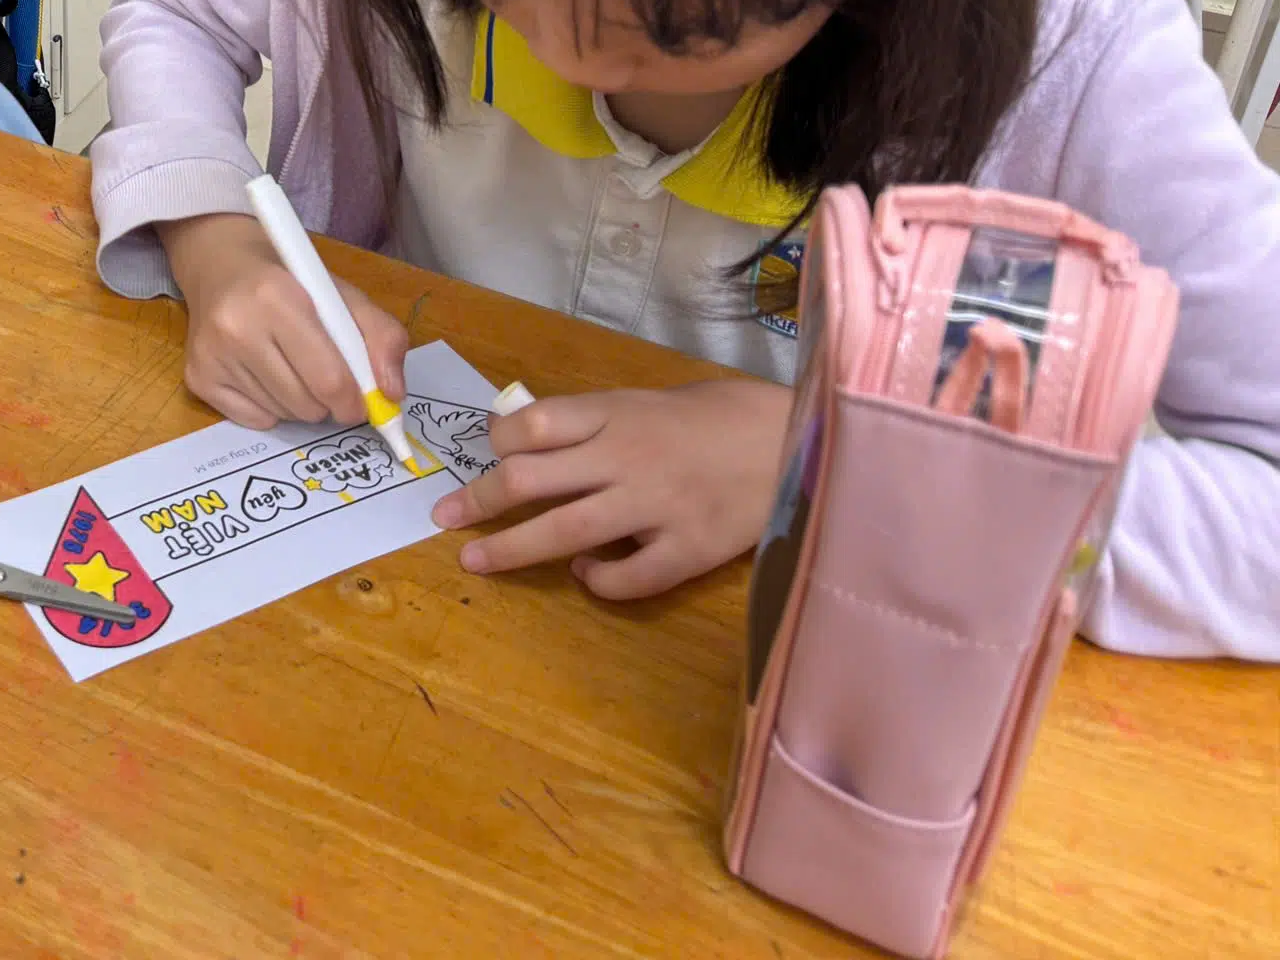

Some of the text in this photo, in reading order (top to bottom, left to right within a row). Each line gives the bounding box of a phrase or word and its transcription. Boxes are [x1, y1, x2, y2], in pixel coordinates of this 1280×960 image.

[304, 444, 370, 475] Nhiên
[334, 463, 371, 485] An
[139, 490, 229, 534] NAM
[247, 485, 287, 509] yêu
[164, 514, 250, 560] VIỆT
